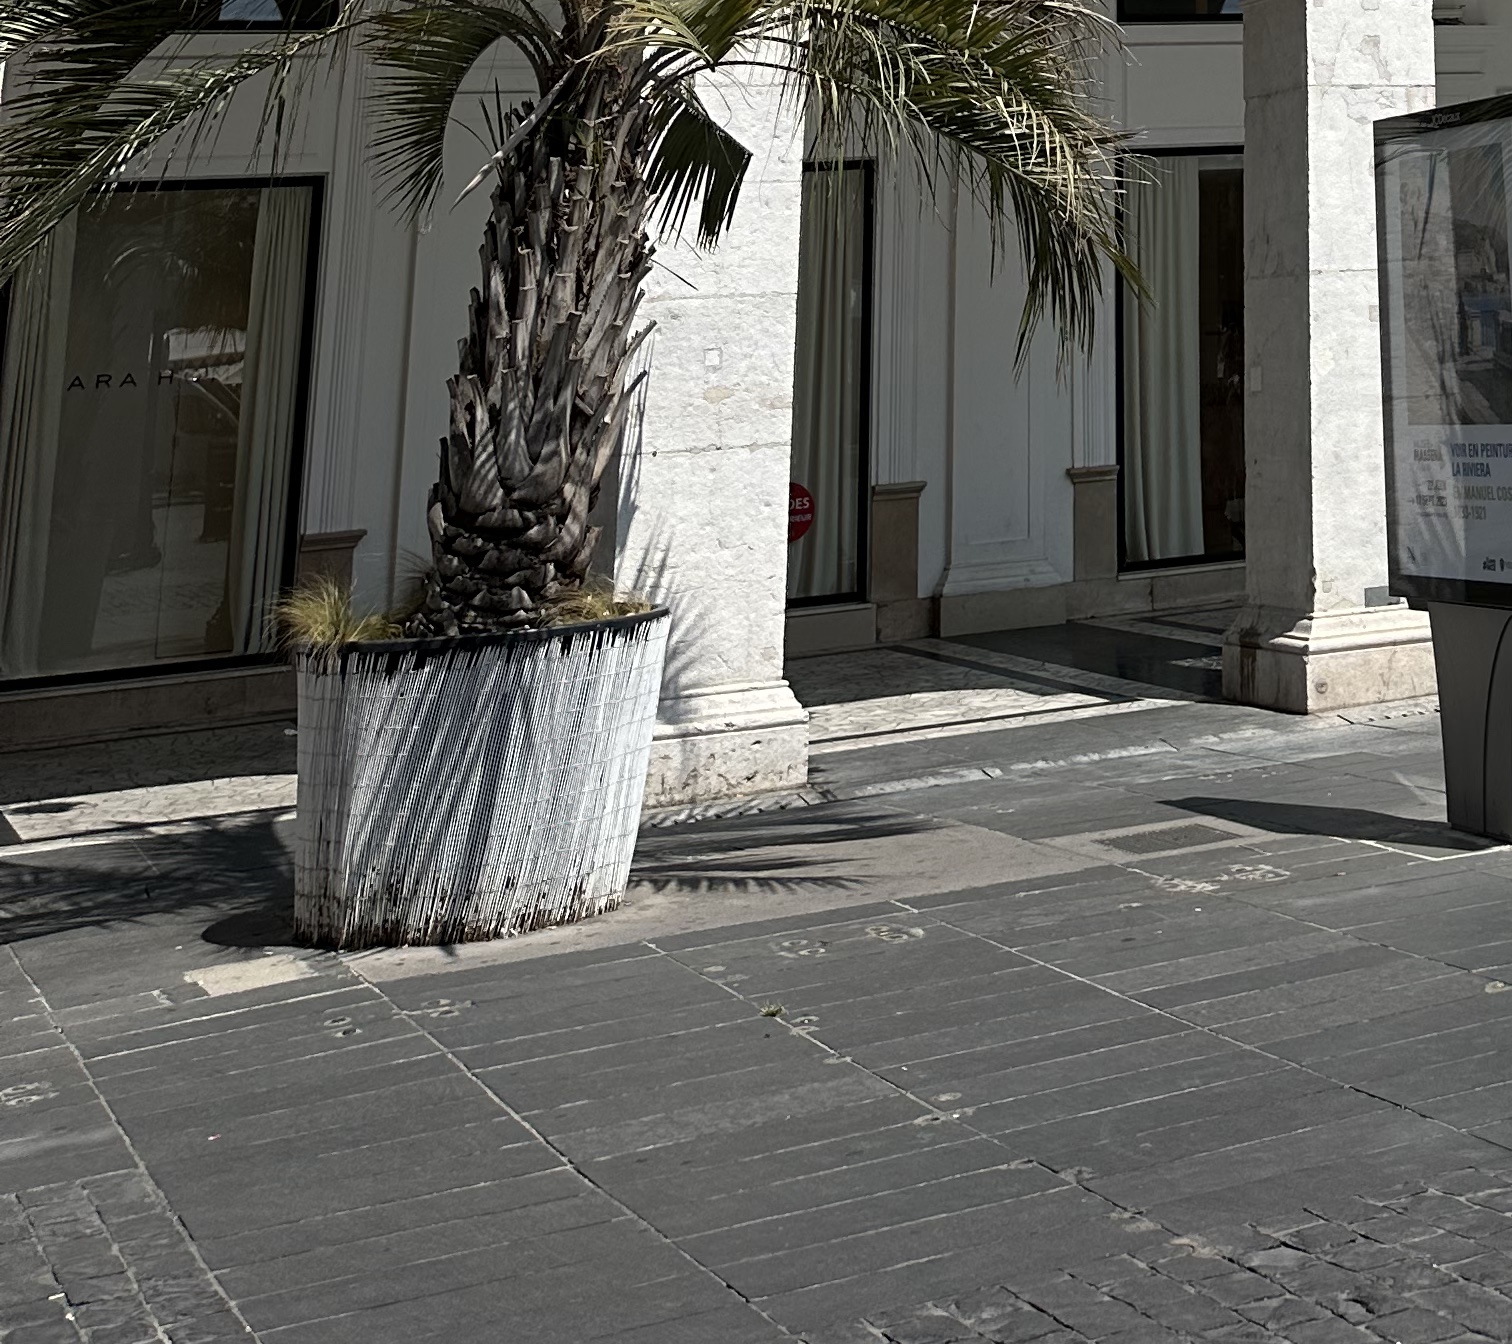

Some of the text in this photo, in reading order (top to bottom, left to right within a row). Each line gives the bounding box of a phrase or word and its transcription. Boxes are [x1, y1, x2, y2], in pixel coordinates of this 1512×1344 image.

[1450, 443, 1467, 458] VOIR
[1468, 443, 1479, 458] EN
[1452, 462, 1491, 478] LA RIVIERA
